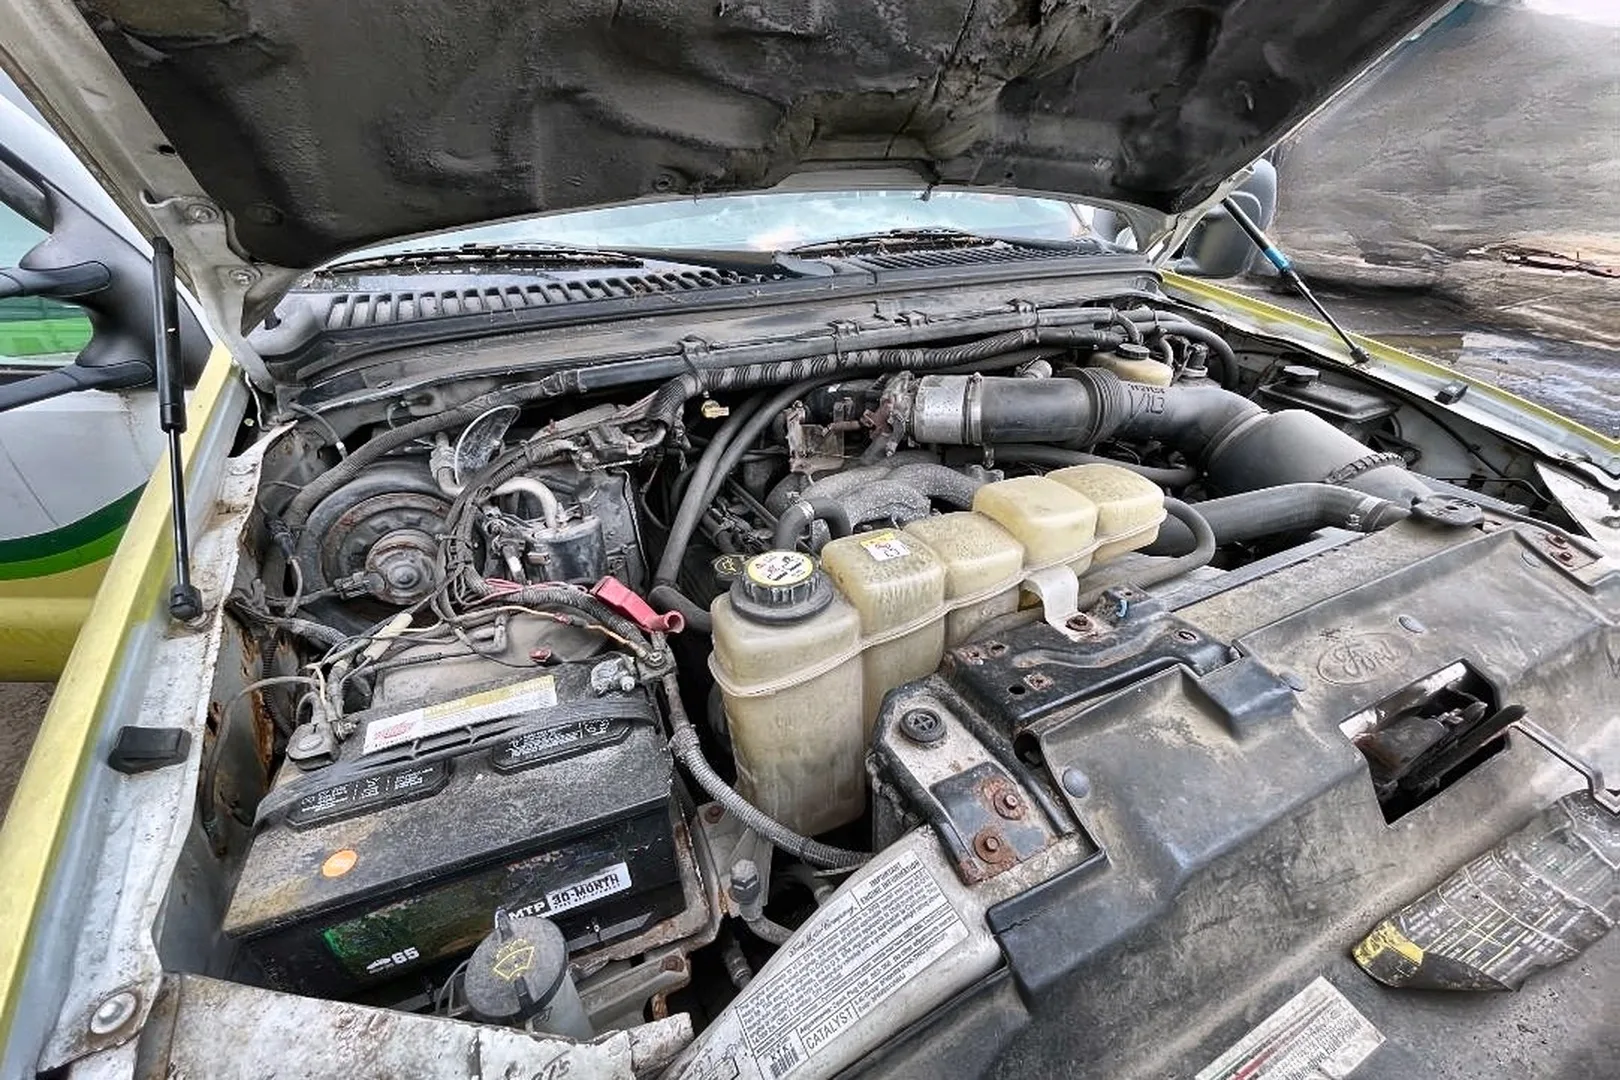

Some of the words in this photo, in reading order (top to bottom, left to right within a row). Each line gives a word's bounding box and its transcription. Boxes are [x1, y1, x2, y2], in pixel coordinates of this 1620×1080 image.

[1332, 639, 1397, 679] Ford
[552, 873, 619, 906] 30-MONTH
[508, 901, 545, 920] MTP
[391, 946, 420, 964] 65
[804, 1005, 855, 1051] CATALYST
